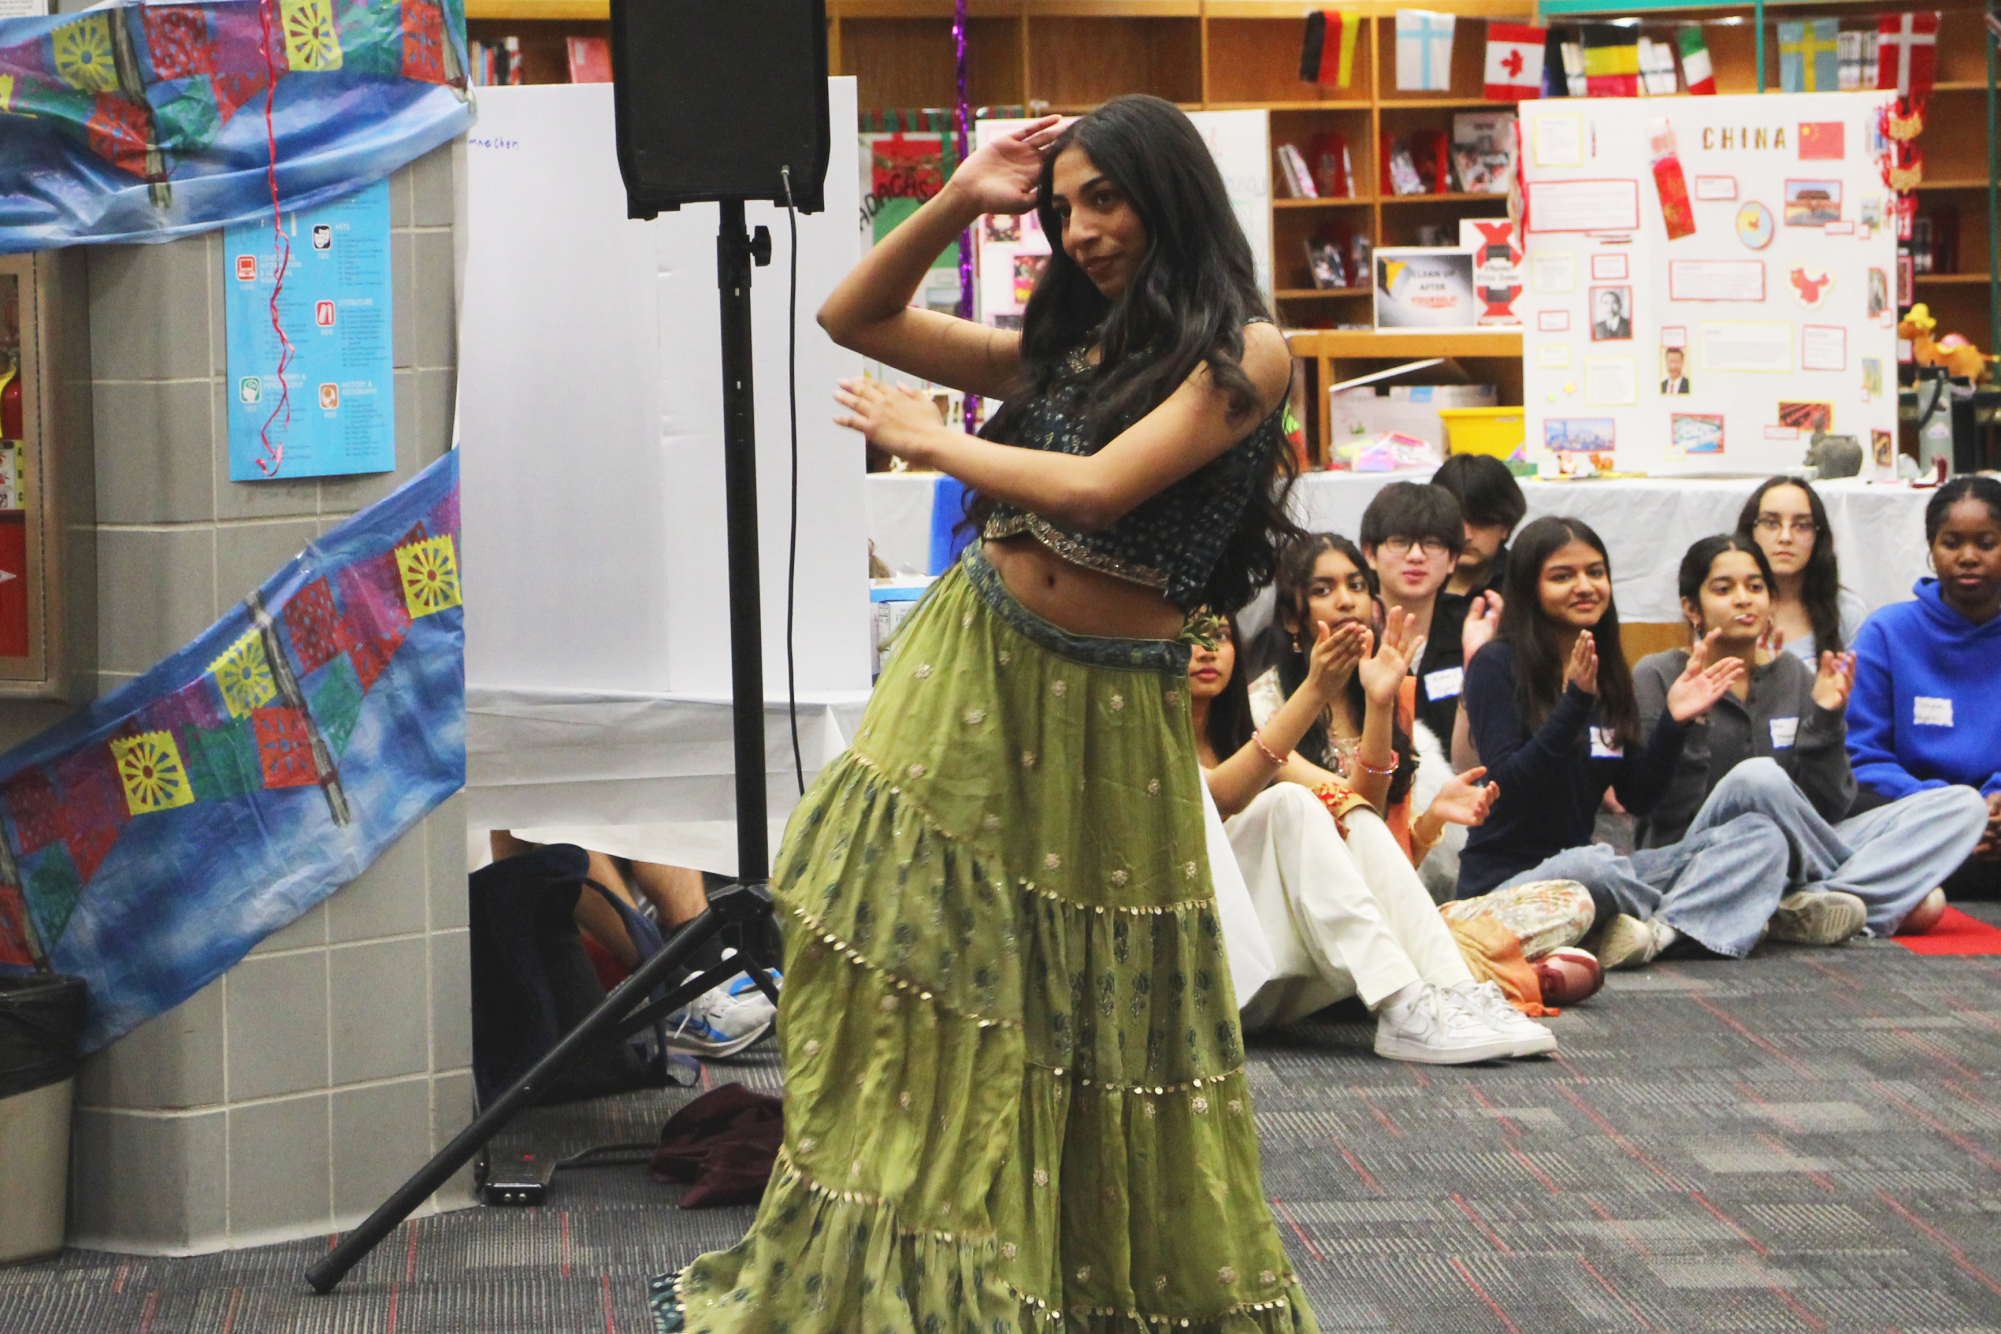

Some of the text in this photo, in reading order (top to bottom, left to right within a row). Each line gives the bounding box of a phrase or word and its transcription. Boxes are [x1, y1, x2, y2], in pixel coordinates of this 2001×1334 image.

[1702, 127, 1786, 150] CHINA
[338, 298, 374, 307] LITERATURE
[341, 380, 367, 388] HISTORY
[341, 387, 377, 396] GEOGRAPHY
